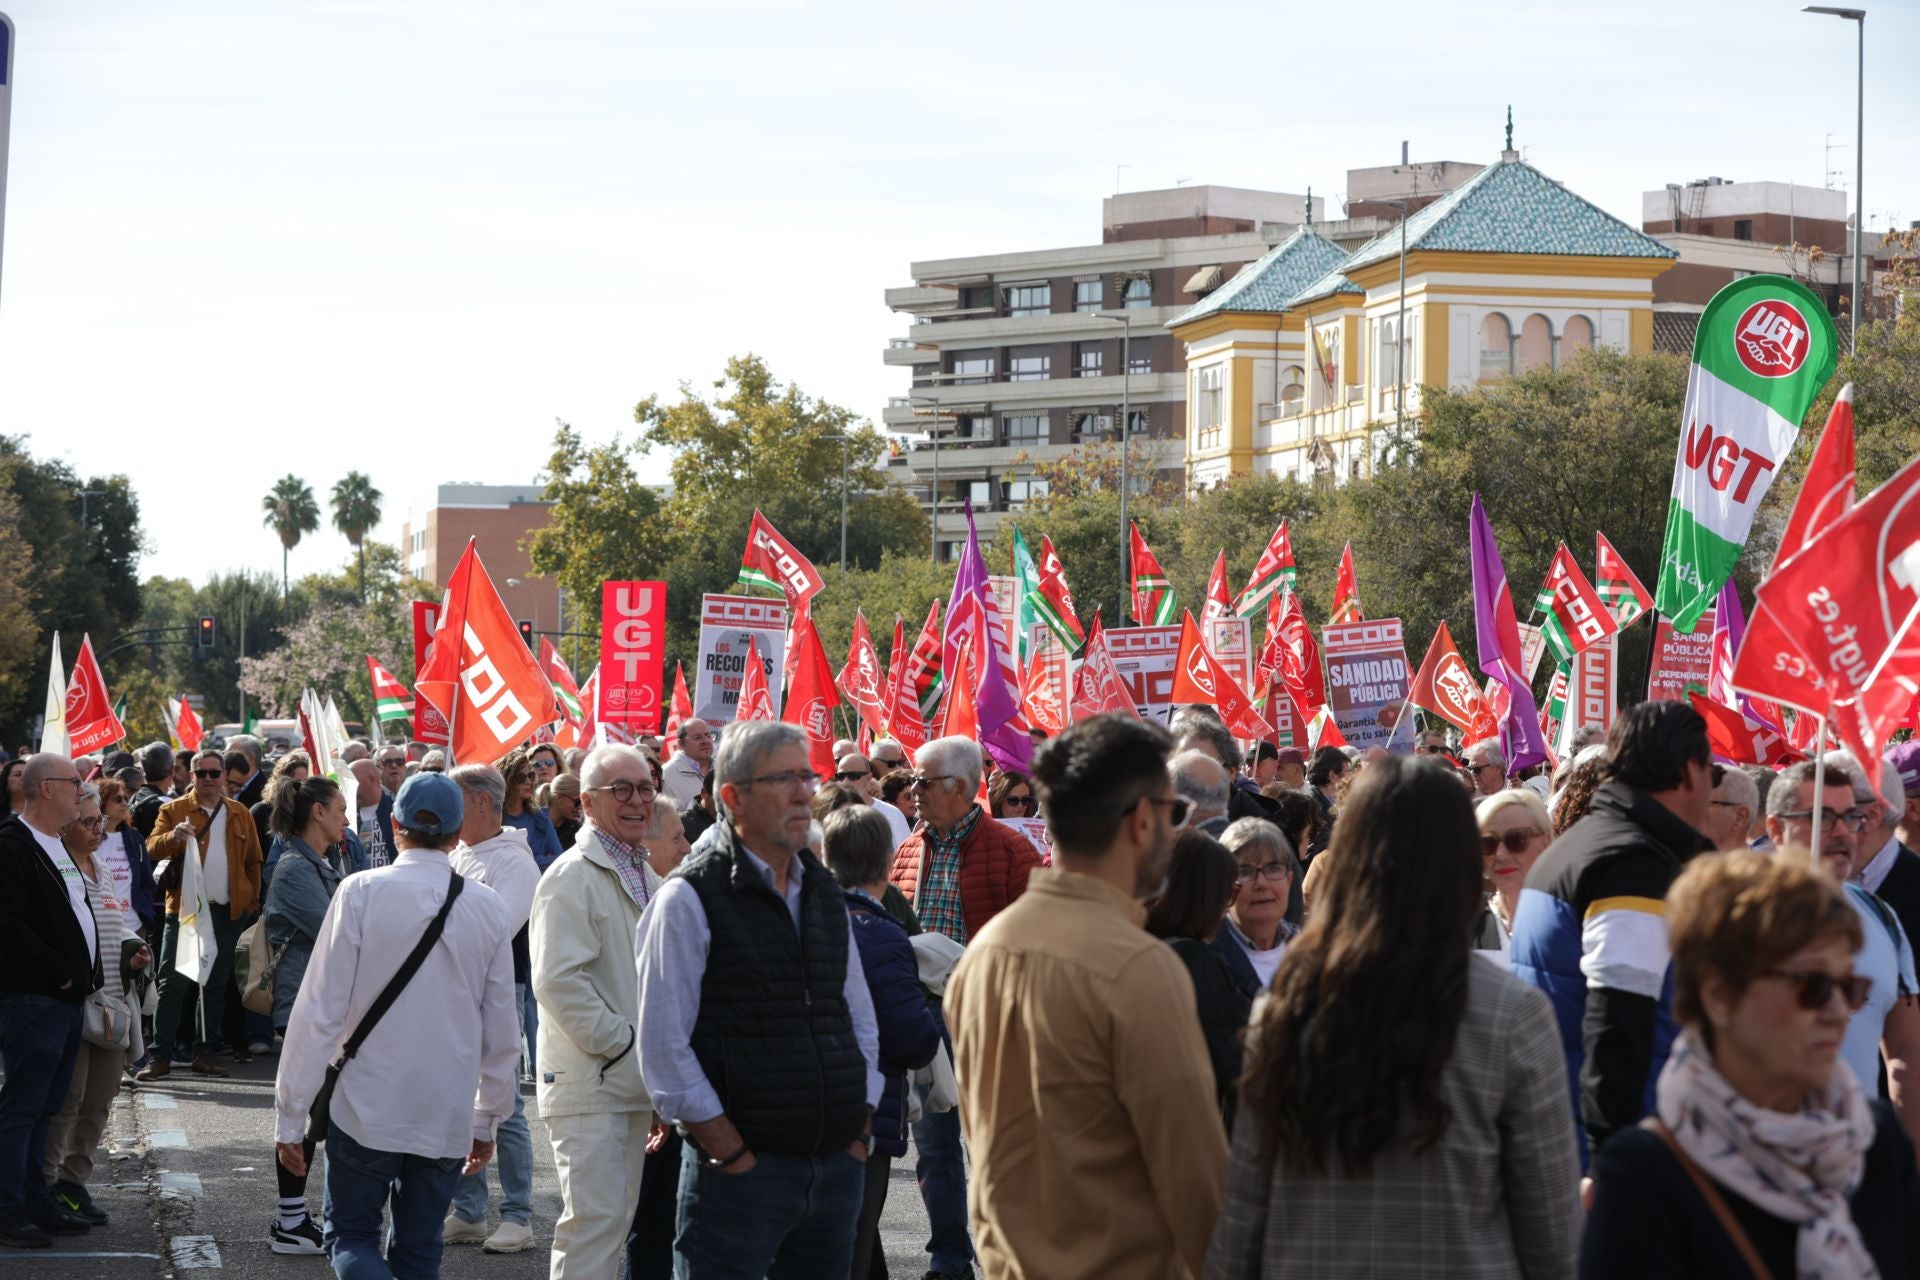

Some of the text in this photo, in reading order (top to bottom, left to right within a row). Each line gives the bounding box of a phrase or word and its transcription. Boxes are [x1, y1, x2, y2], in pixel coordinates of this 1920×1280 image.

[1750, 306, 1805, 357] UGT
[1684, 418, 1775, 505] UGT
[753, 527, 811, 595] CCOO
[703, 601, 786, 623] CCOO
[613, 588, 653, 682] UGT
[716, 642, 730, 653] LOS
[1323, 624, 1402, 647] CCOO
[1330, 659, 1405, 686] SANIDAD
[1350, 683, 1401, 704] PÚBLICA
[1343, 732, 1360, 742] ara
[1363, 730, 1372, 739] tu
